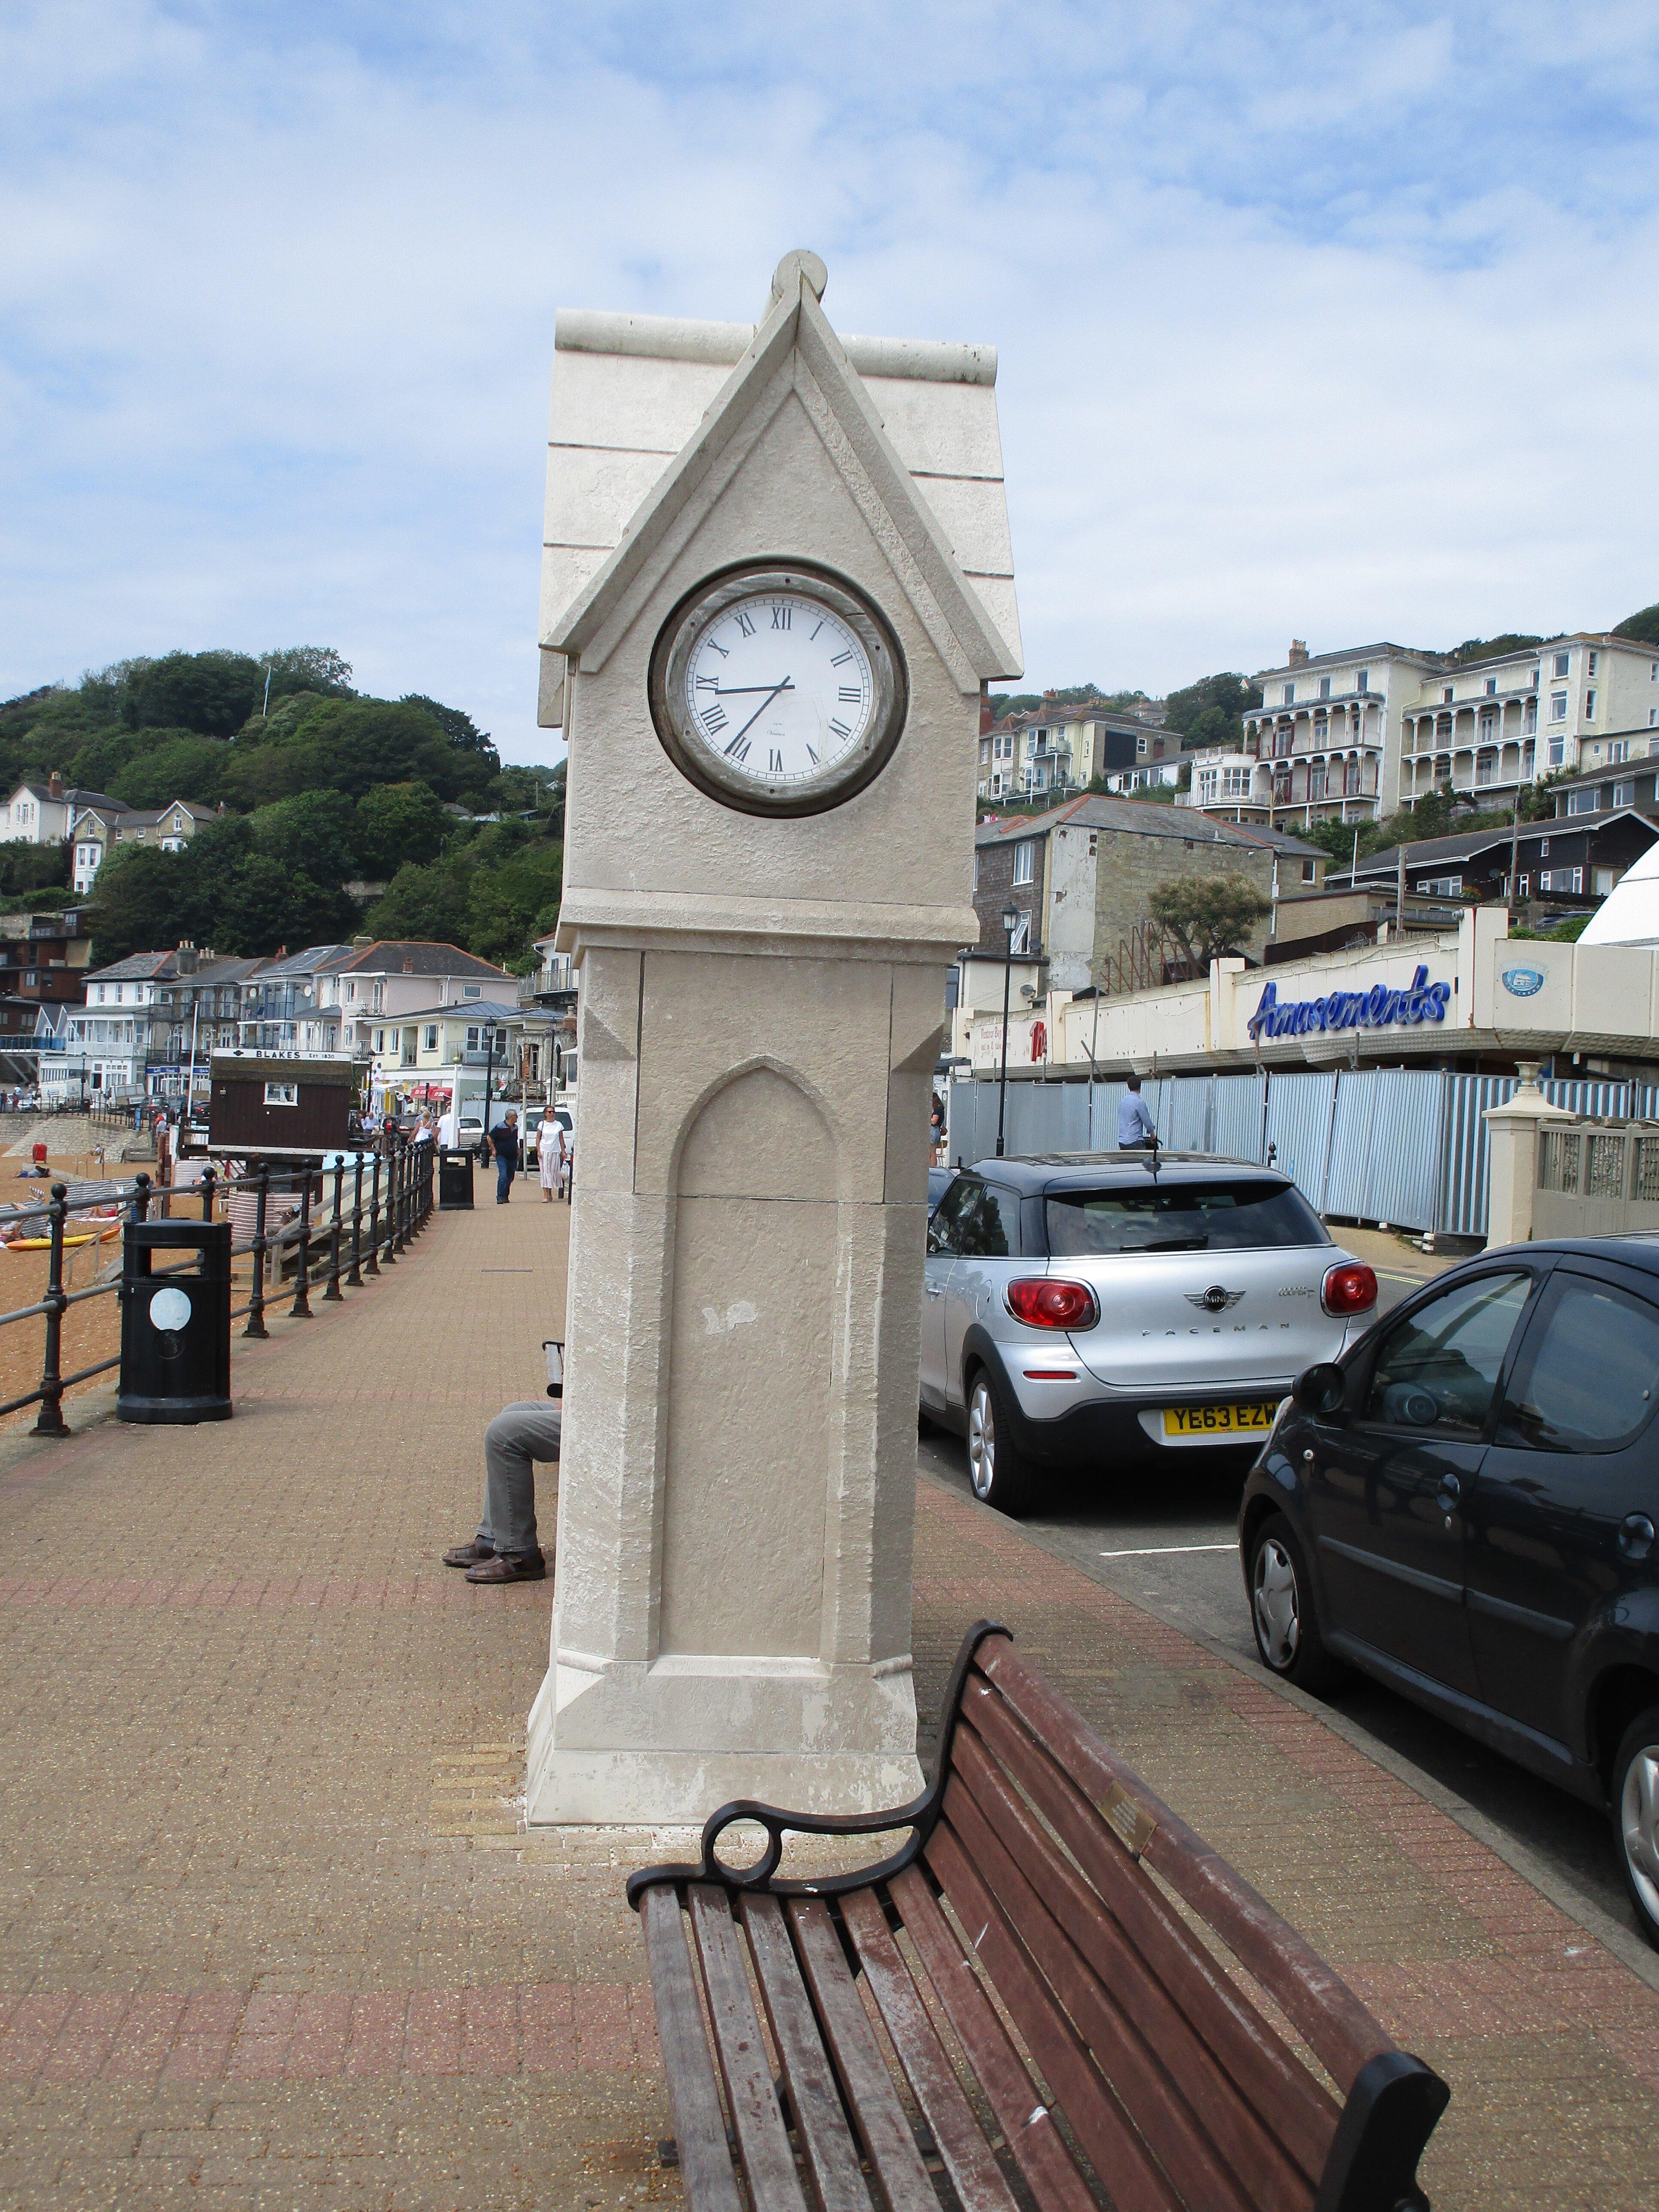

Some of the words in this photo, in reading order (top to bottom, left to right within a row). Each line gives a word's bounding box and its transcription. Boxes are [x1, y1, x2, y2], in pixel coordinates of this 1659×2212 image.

[734, 612, 757, 638] XI
[771, 607, 792, 630] XII
[809, 621, 824, 641] I
[708, 638, 730, 659] X
[830, 650, 854, 668] II
[696, 675, 719, 690] IX
[839, 686, 861, 704] III
[699, 703, 729, 736] VIII
[769, 749, 783, 772] VI
[806, 744, 820, 765] V
[1247, 965, 1450, 1039] Amusements
[256, 1051, 300, 1059] BLAKES
[1206, 1295, 1226, 1304] MINI
[1142, 1322, 1289, 1336] PACEMAN
[1174, 1407, 1231, 1430] YE63
